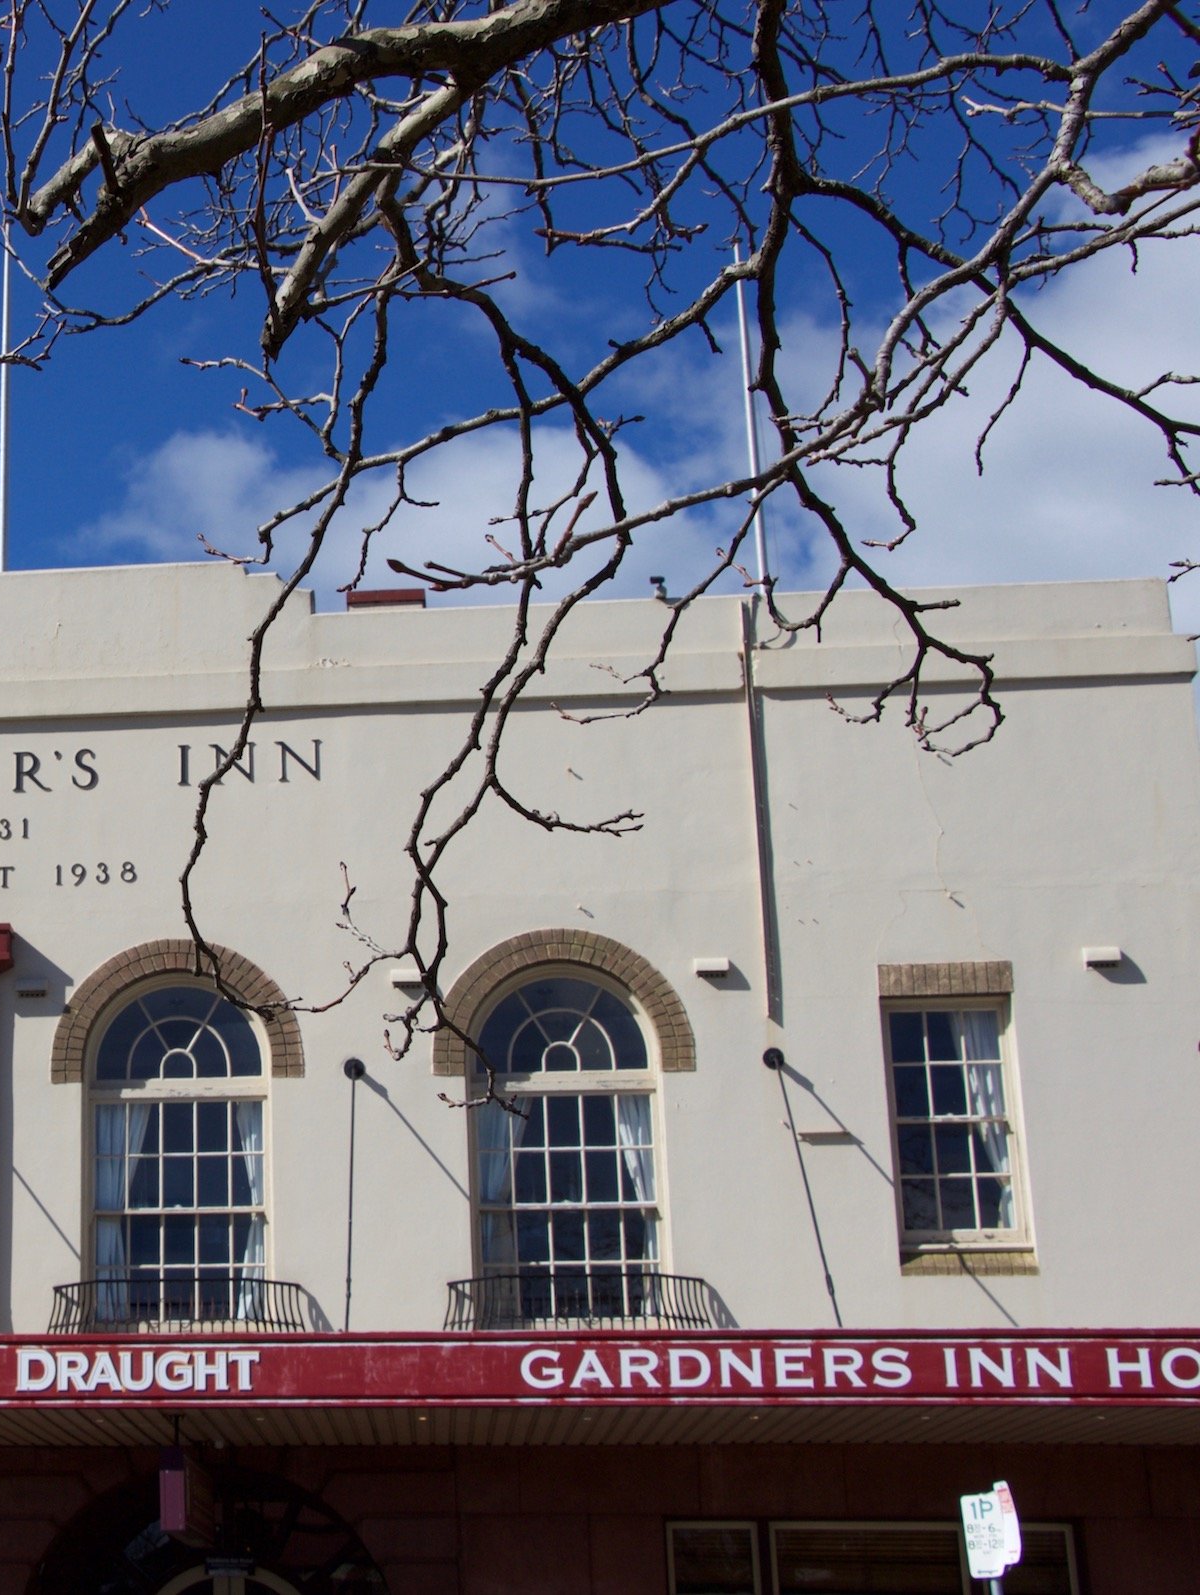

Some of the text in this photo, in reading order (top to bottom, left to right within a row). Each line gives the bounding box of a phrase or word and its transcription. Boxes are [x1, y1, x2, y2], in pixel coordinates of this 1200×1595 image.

[177, 738, 323, 787] INN
[54, 861, 138, 887] 1938
[15, 1349, 260, 1391] DRAUGHT
[519, 1347, 1200, 1389] GARDNERS INN HO
[971, 1500, 993, 1519] 1P
